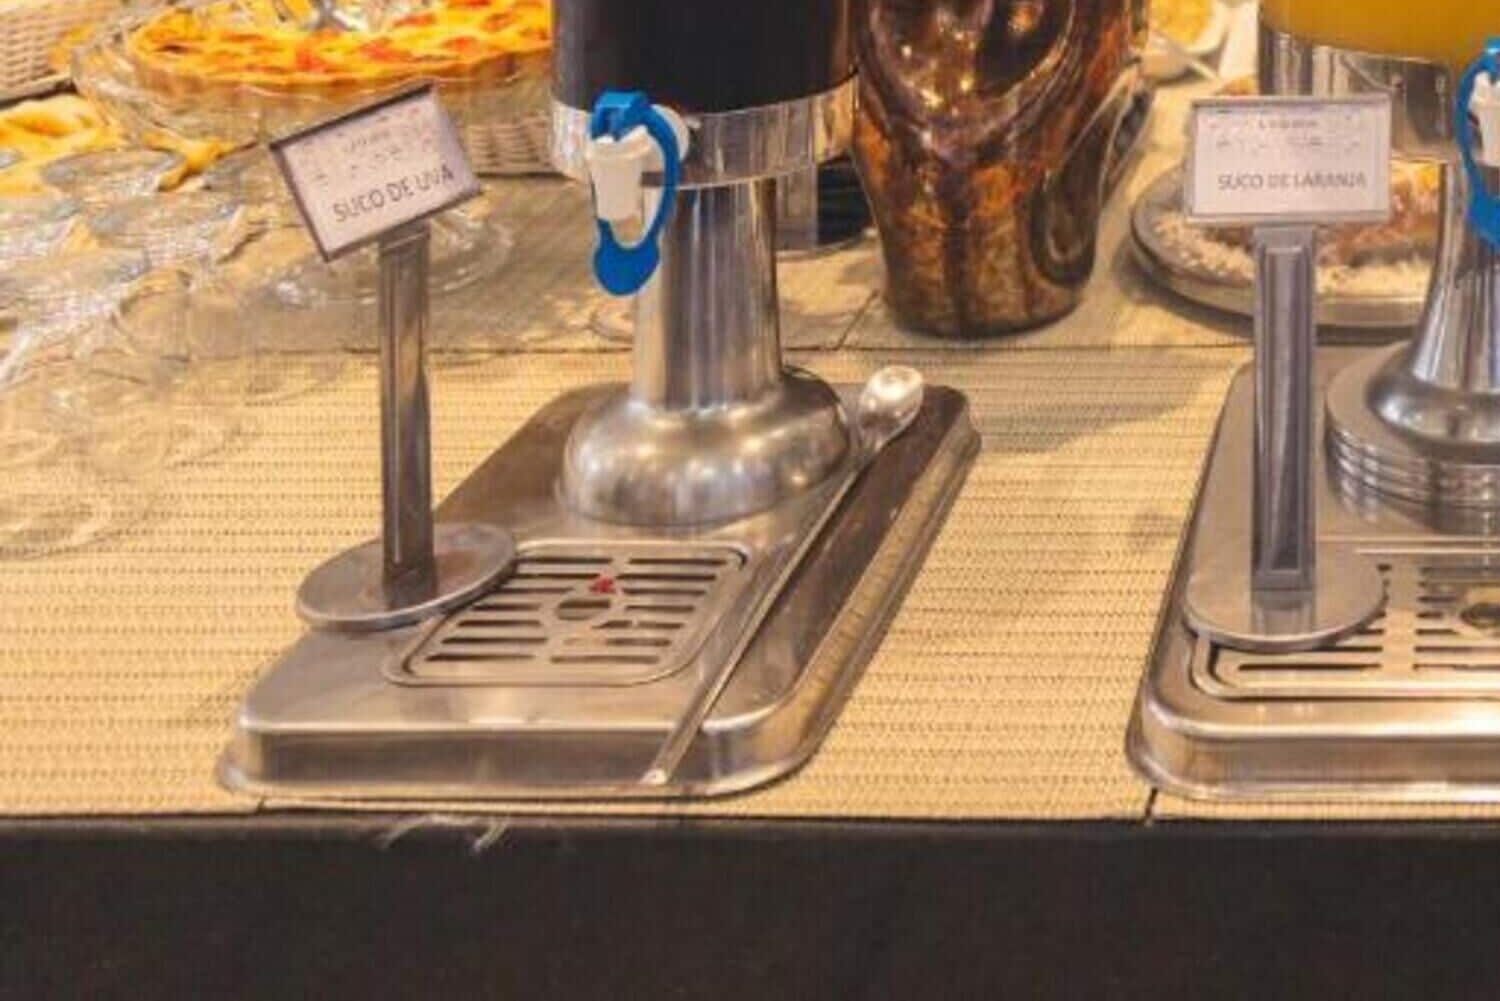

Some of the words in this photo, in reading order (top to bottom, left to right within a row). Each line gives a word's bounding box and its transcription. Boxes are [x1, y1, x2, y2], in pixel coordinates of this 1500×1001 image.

[333, 188, 386, 222] SUCO
[385, 176, 415, 203] DE
[414, 164, 455, 191] UVA
[1217, 173, 1264, 190] SUCO
[1268, 173, 1291, 189] DE
[1293, 171, 1367, 189] LARANJA
